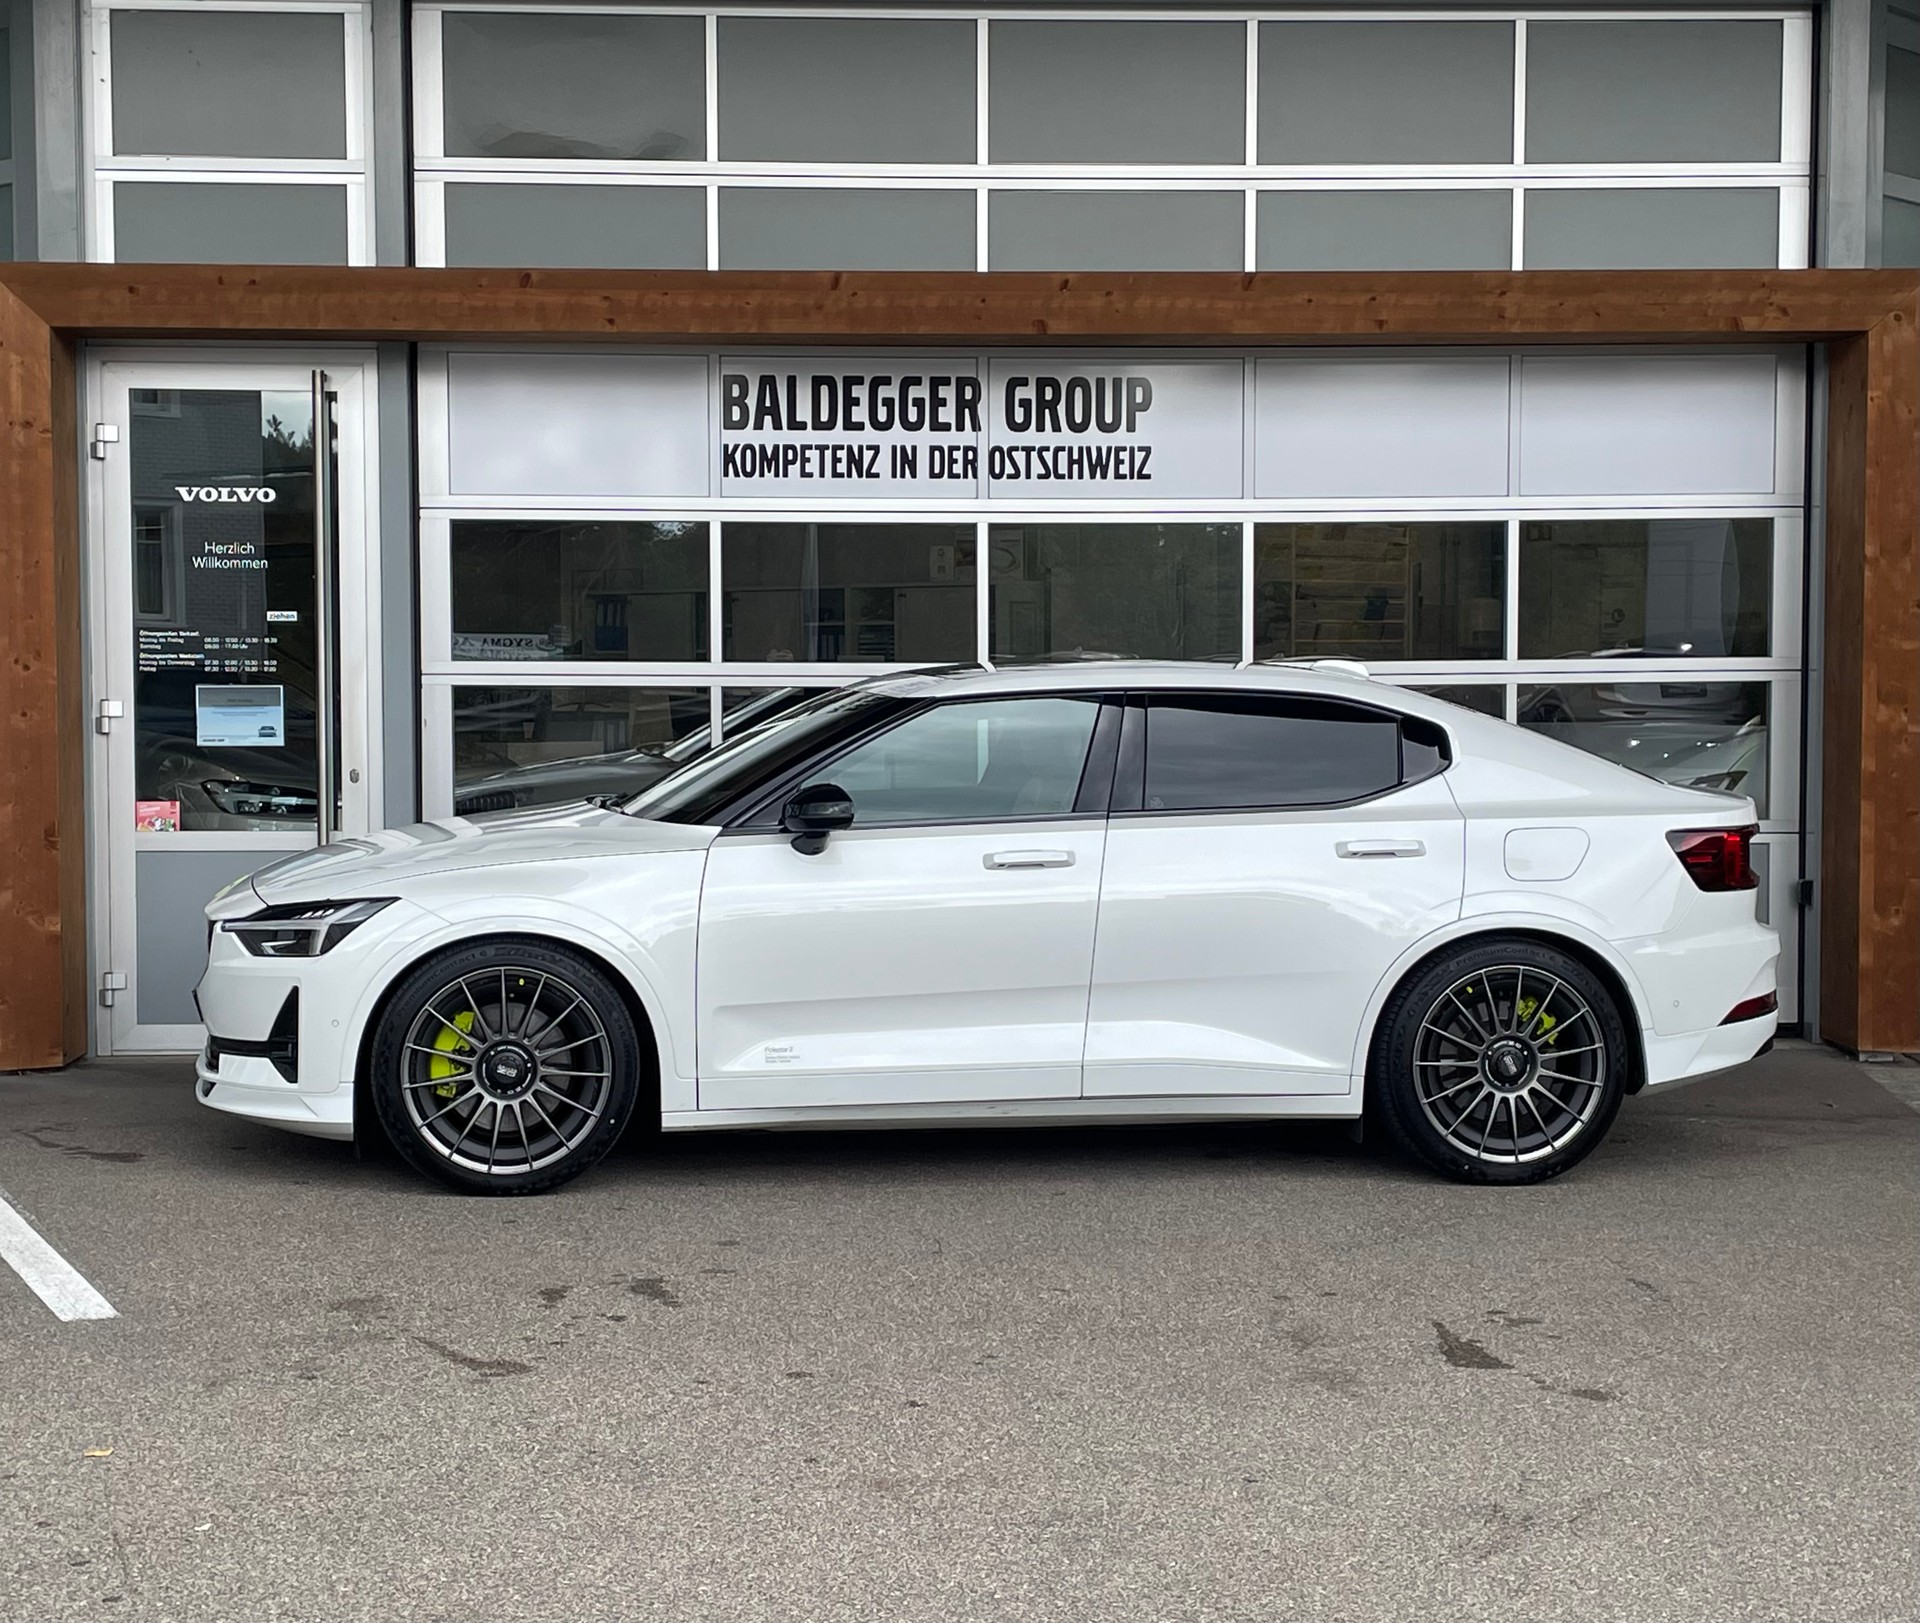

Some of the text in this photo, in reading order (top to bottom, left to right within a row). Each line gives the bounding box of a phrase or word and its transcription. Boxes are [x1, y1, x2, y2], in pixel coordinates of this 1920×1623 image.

[722, 375, 1152, 433] BALDEGGER GROUP
[722, 443, 1152, 481] KOMPETENZ IN DER OSTSCHWEIZ
[175, 487, 276, 503] VOLVO
[204, 542, 255, 555] Herzlich
[192, 557, 268, 569] Willkommen
[1455, 946, 1546, 967] PremiumContact
